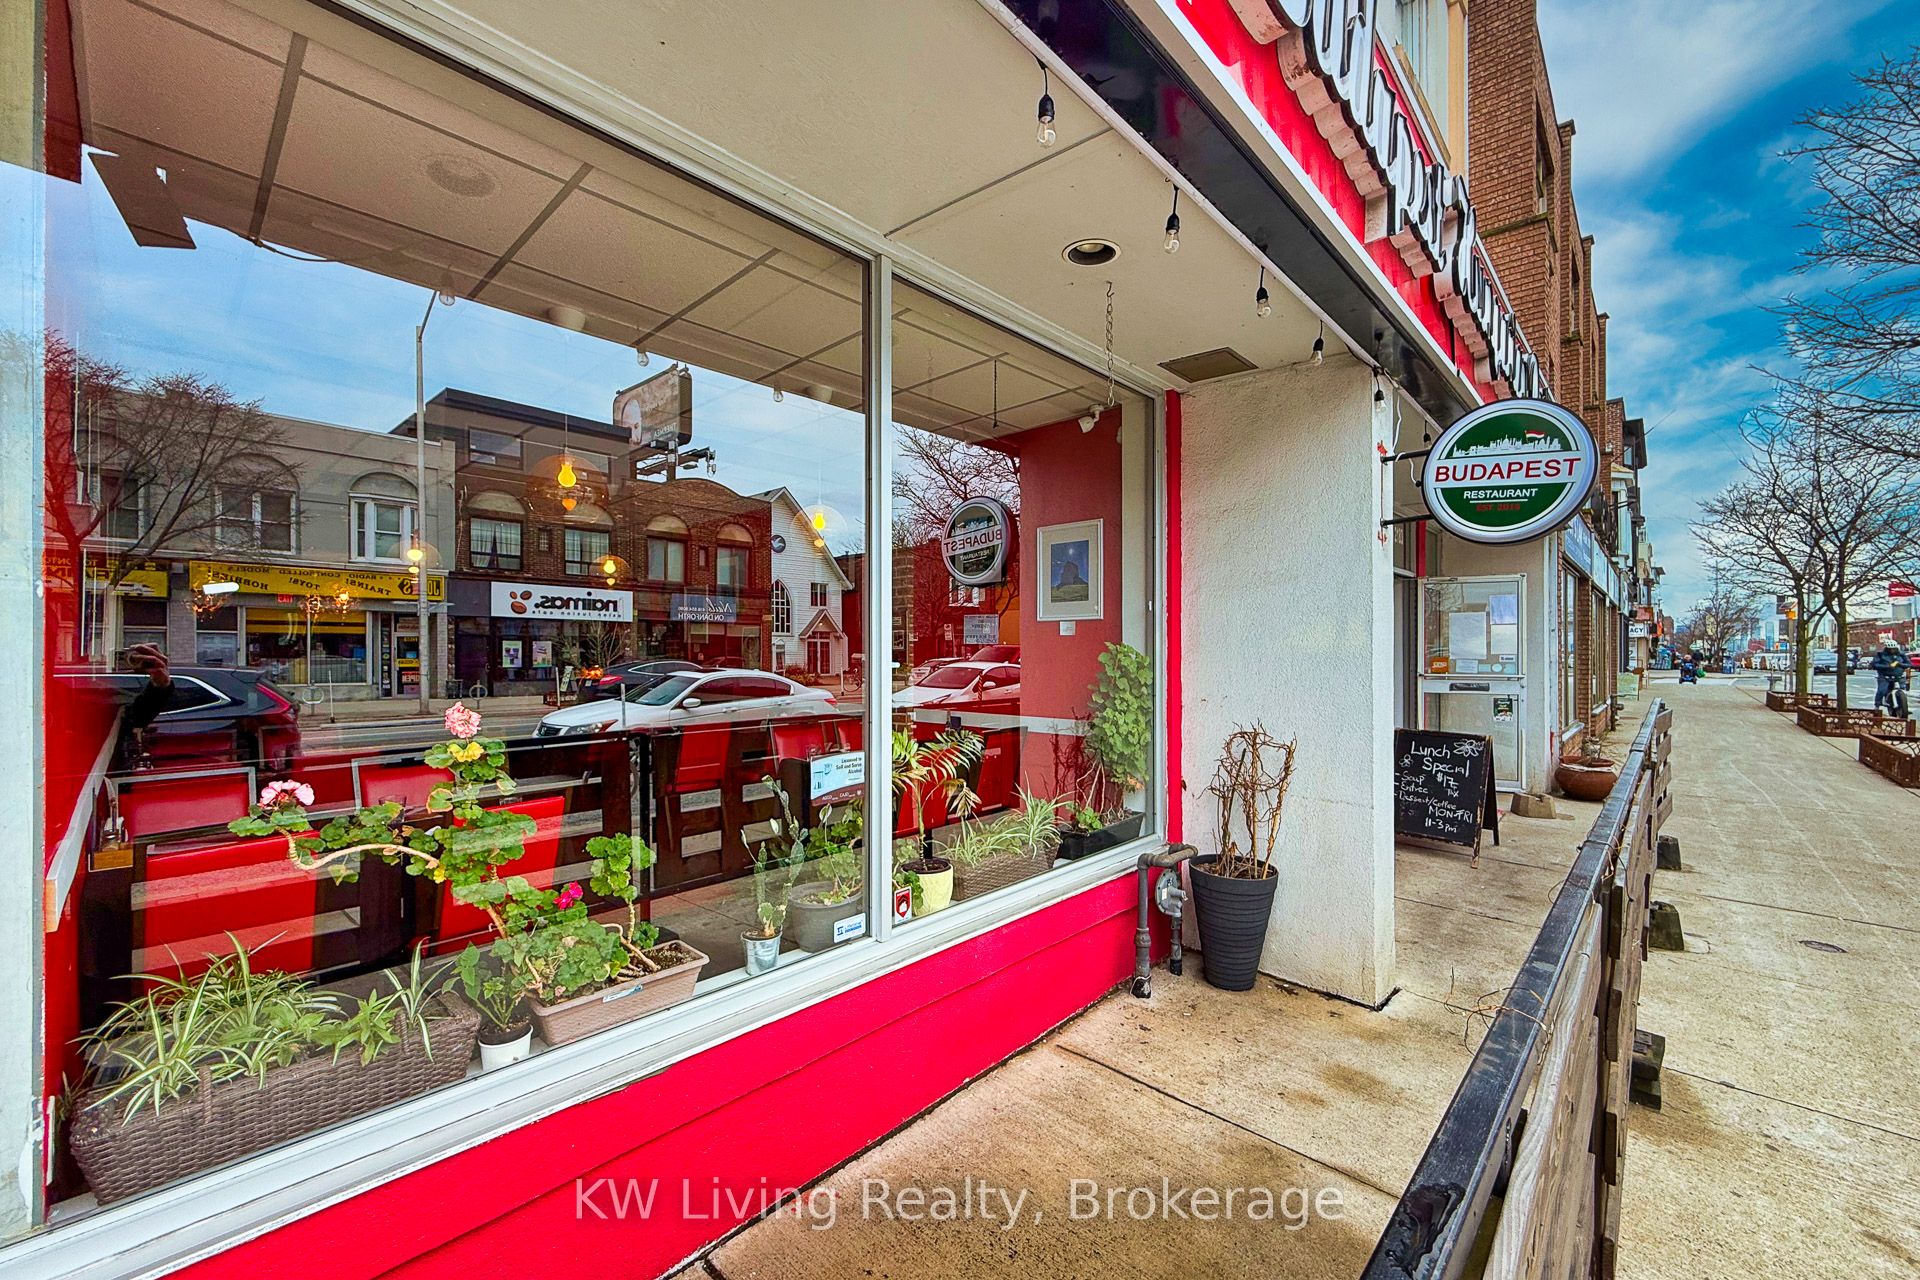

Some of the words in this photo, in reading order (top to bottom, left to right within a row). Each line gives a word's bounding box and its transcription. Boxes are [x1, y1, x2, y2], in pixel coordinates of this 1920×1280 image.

[1434, 457, 1582, 483] BUDAPEST
[1463, 487, 1539, 499] RESTAURANT
[1410, 741, 1451, 759] Lunch
[1422, 757, 1470, 778] Special
[1401, 771, 1425, 785] Soup
